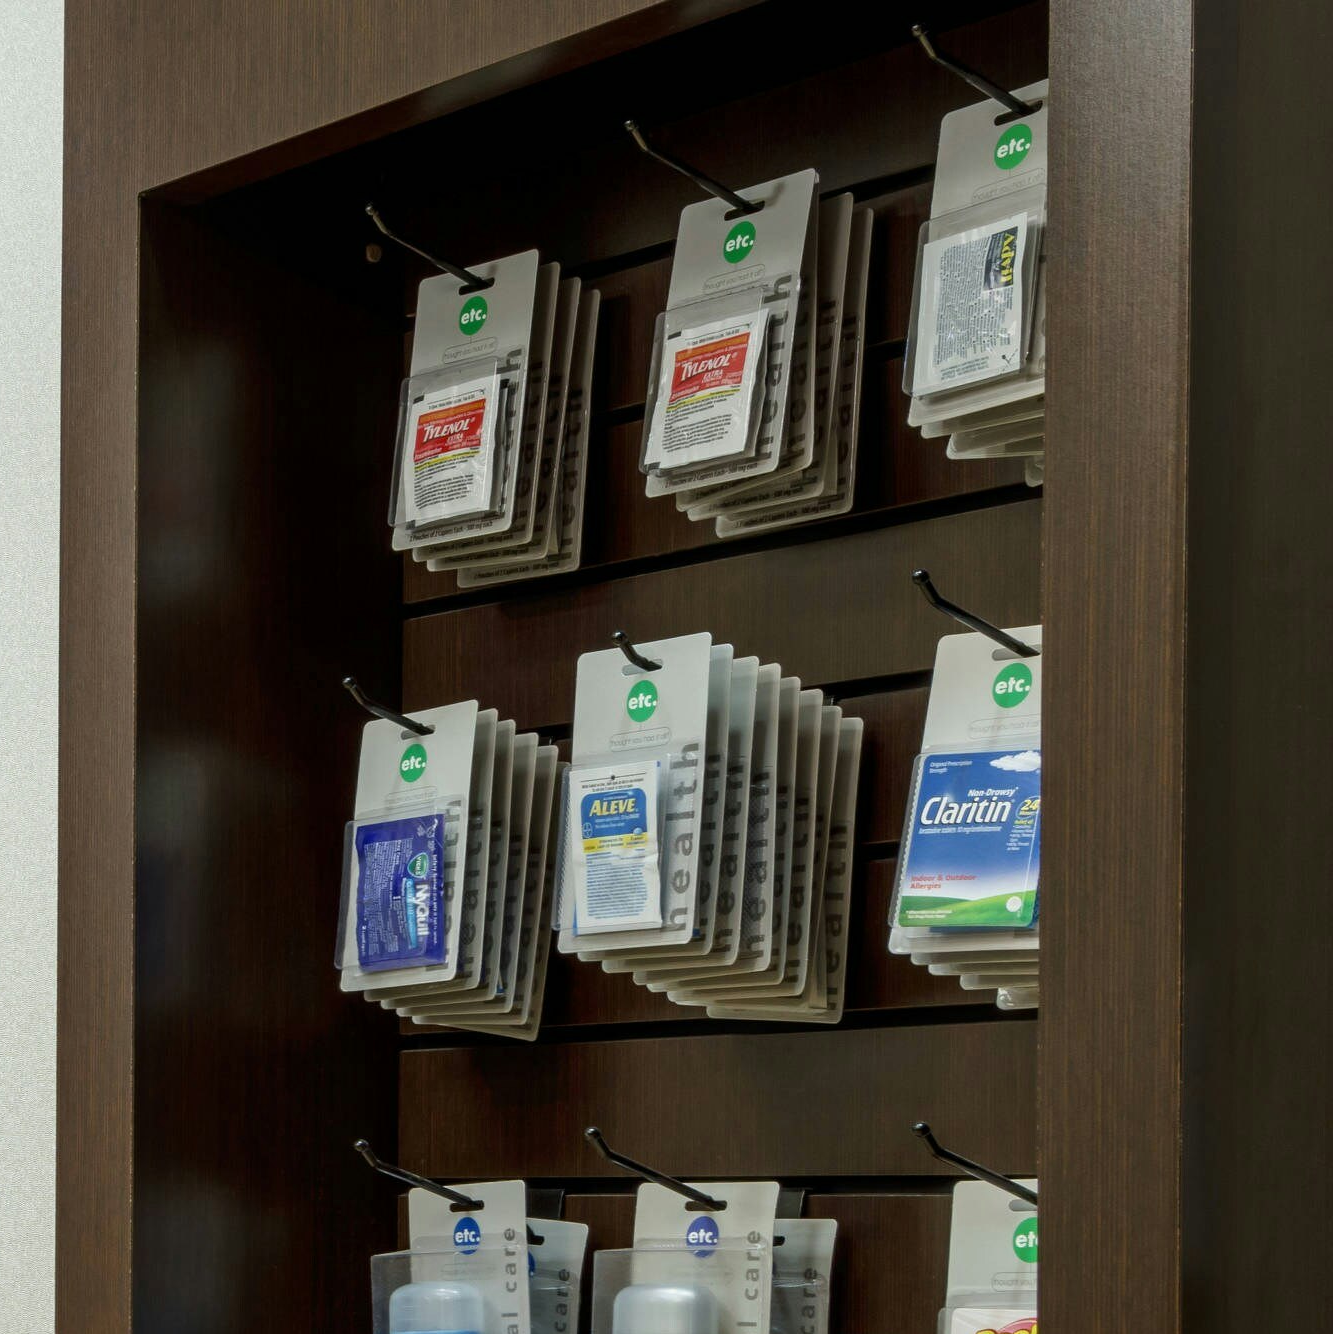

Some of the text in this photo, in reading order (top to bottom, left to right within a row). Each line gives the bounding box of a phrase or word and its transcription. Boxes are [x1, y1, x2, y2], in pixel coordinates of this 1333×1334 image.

[997, 137, 1031, 159] etc.
[725, 234, 755, 252] etc.
[1000, 232, 1017, 283] Advil
[460, 308, 487, 326] etc.
[681, 354, 731, 381] TYLENOL
[423, 419, 471, 443] TYLENOL
[995, 675, 1032, 694] etc.
[628, 694, 658, 710] etc.
[401, 756, 426, 771] etc.
[588, 797, 637, 818] ALEVE
[921, 797, 1011, 825] Claritin
[1021, 800, 1040, 811] 24
[667, 743, 700, 931] health
[910, 882, 941, 890] Allergies
[412, 884, 429, 936] NyQuil
[455, 1229, 480, 1243] etc.
[688, 1228, 718, 1245] etc.
[503, 1227, 517, 1293] care
[746, 1230, 762, 1301] care
[554, 1268, 571, 1333] care
